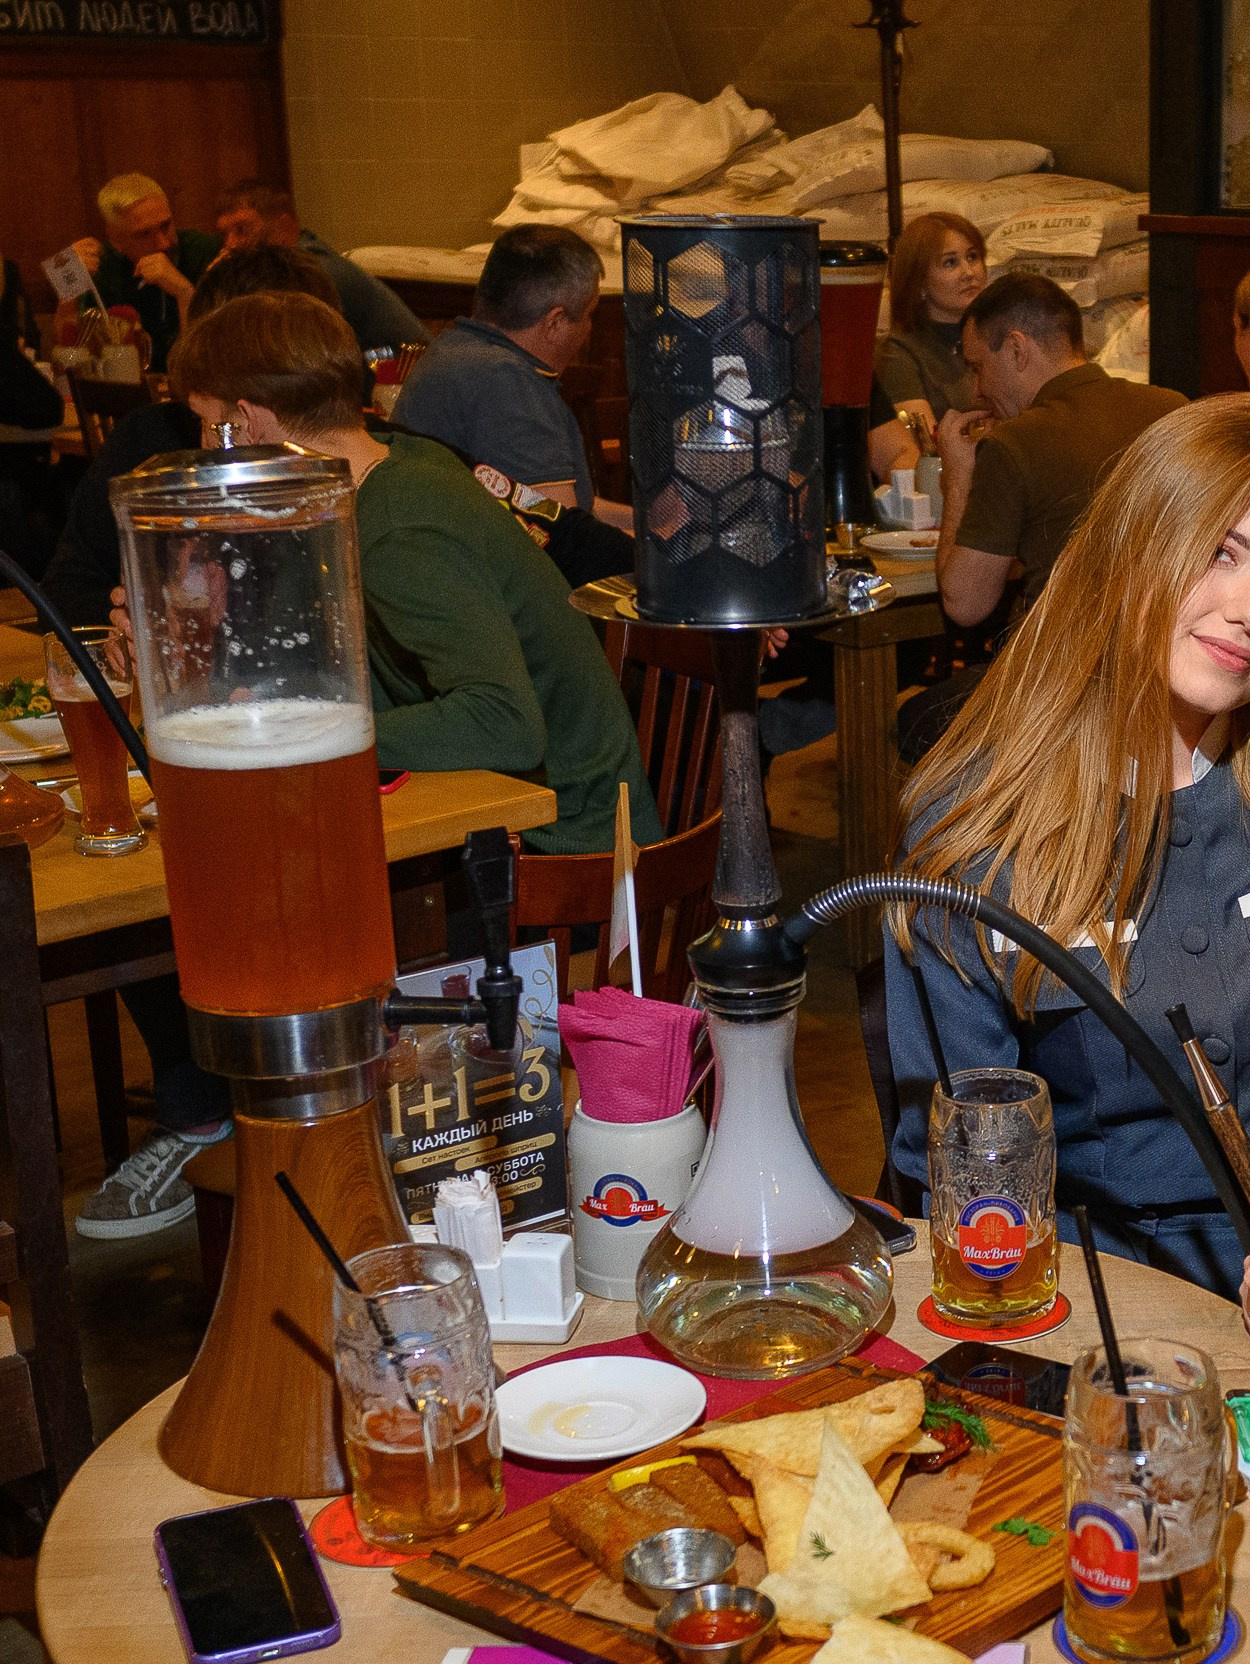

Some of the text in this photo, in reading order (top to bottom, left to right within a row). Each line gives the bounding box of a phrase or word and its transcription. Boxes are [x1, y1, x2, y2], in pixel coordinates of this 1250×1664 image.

[188, 1, 261, 36] ВОДА
[387, 1046, 550, 1139] 1+1=3
[412, 1109, 534, 1153] КАЖДЫЙ ДЕНЬ
[405, 1151, 545, 1199] ПЯТНА СУББОТА
[588, 1198, 608, 1211] Max
